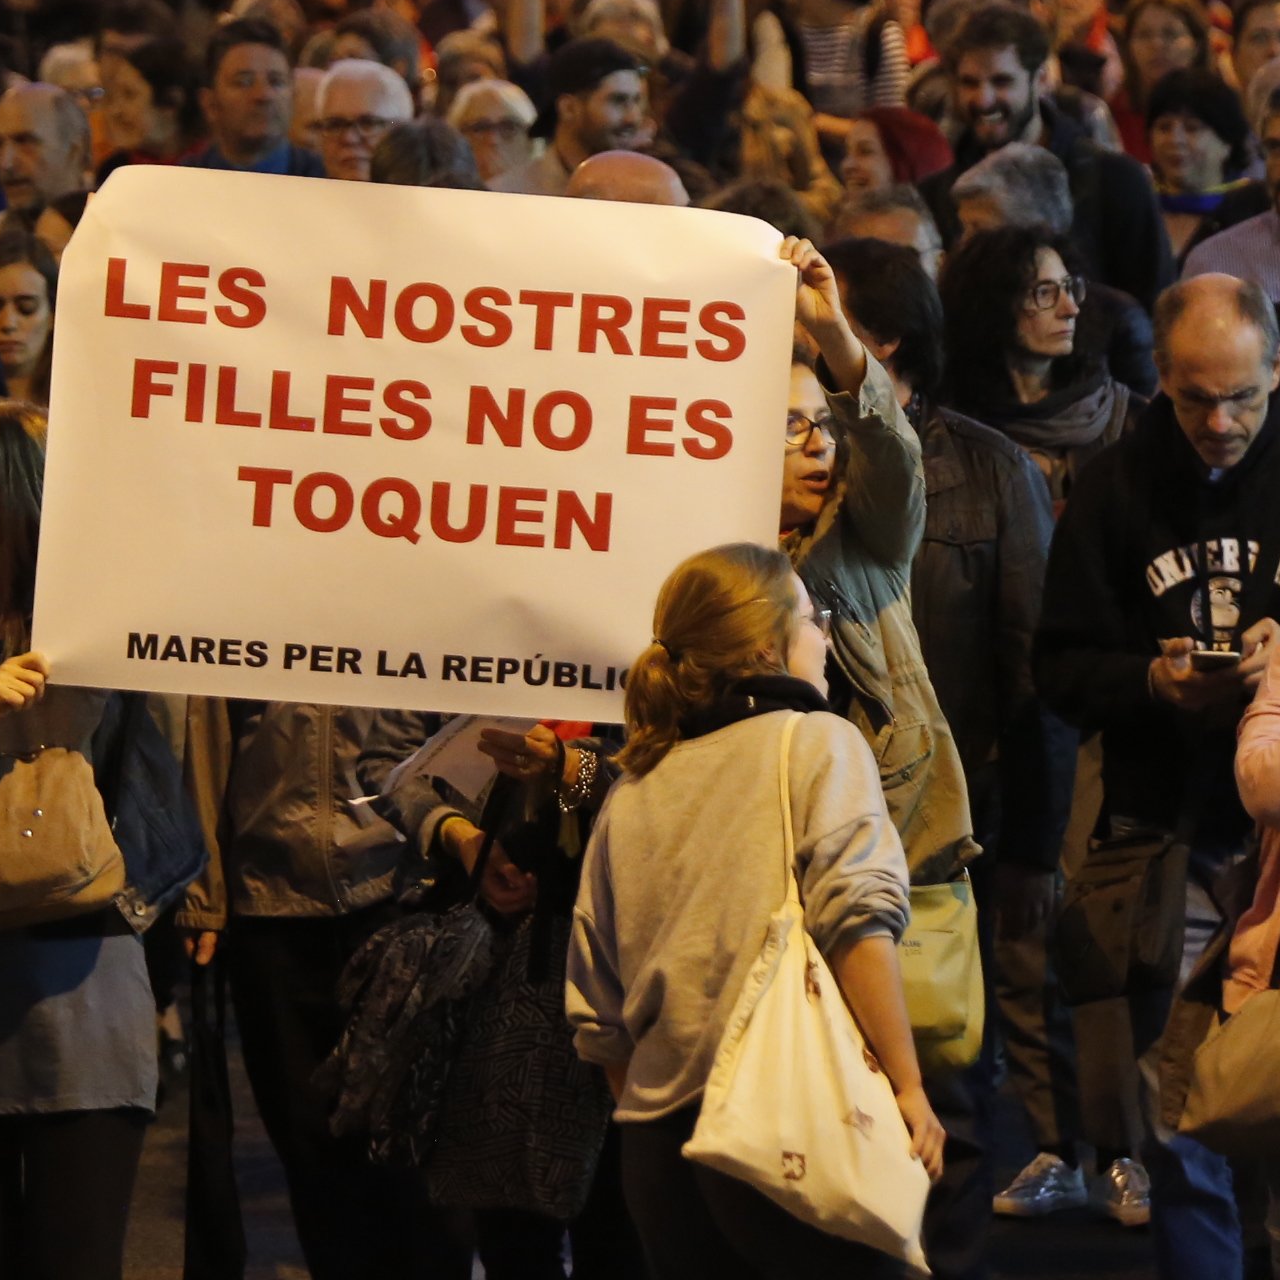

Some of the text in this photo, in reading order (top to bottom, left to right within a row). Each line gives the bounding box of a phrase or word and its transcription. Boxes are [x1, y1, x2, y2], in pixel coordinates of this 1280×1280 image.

[104, 257, 746, 363] LES NOSTRES
[131, 358, 734, 461] FILLES NO ES
[238, 466, 613, 553] TOQUEN
[126, 632, 269, 668] MARES
[283, 643, 363, 675] PER
[376, 650, 427, 679] LA
